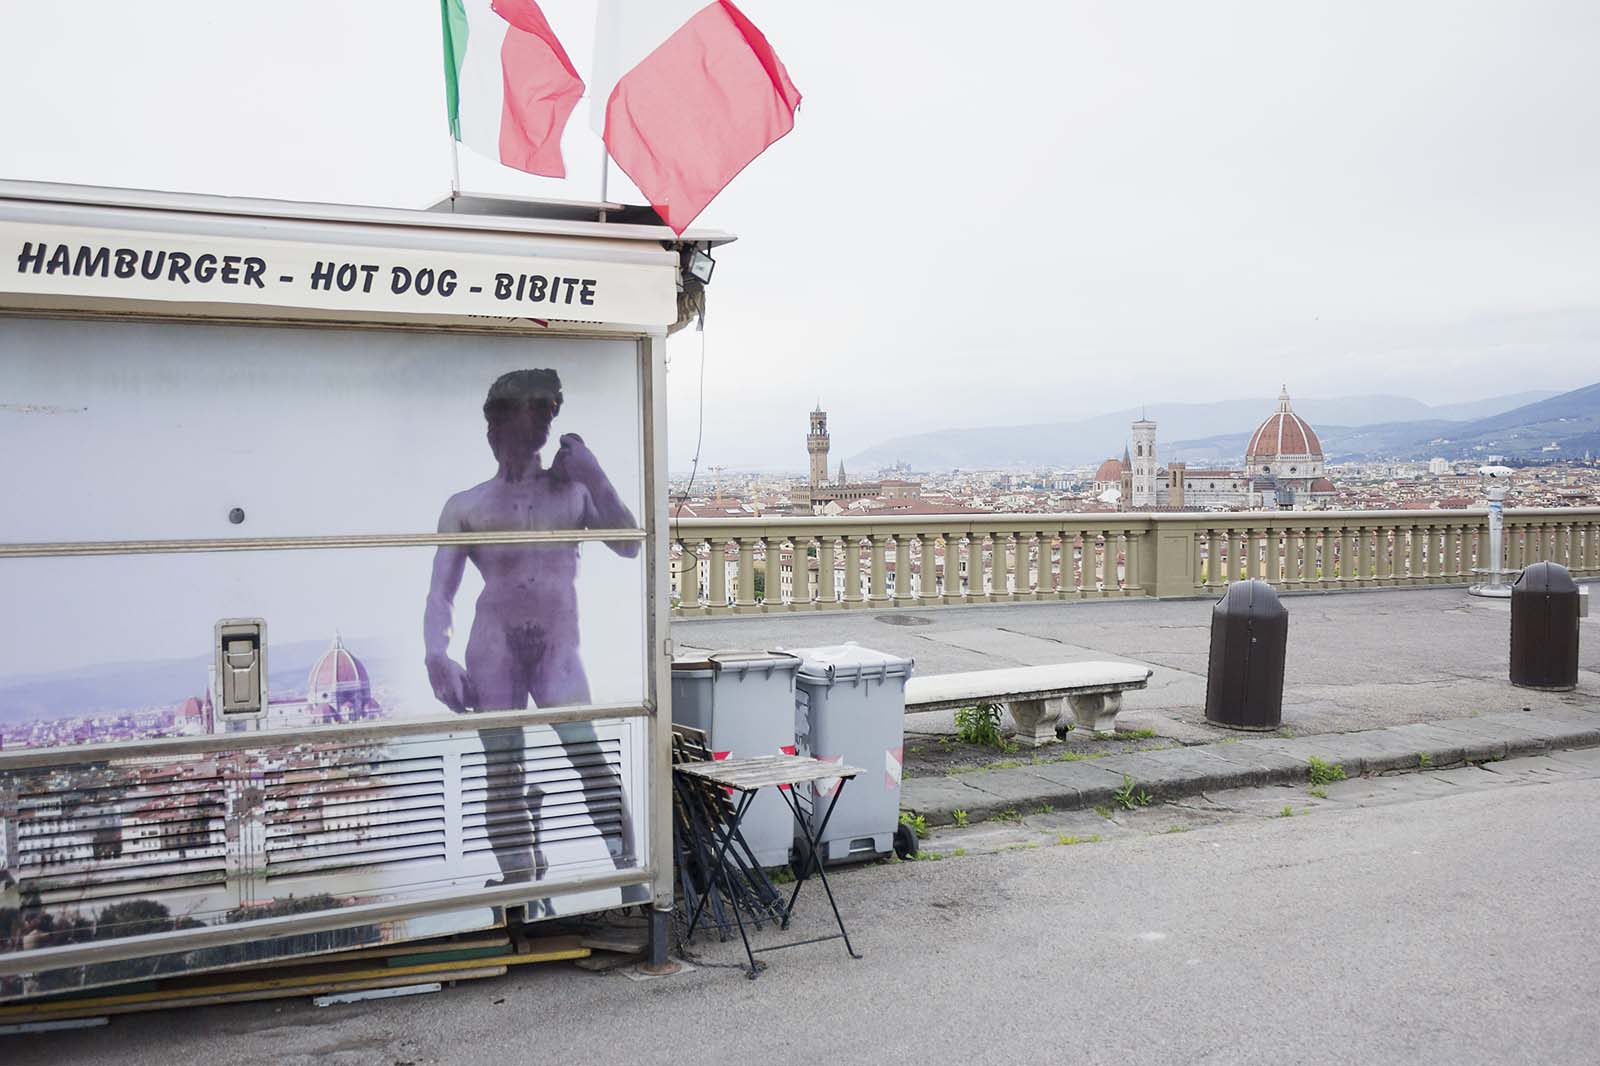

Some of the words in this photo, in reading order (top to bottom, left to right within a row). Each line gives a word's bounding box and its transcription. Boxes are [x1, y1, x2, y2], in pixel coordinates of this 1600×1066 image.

[18, 241, 267, 289] HAMBURGER
[310, 261, 380, 293] HOT
[390, 266, 458, 297] DOG
[494, 272, 597, 306] BIBITE
